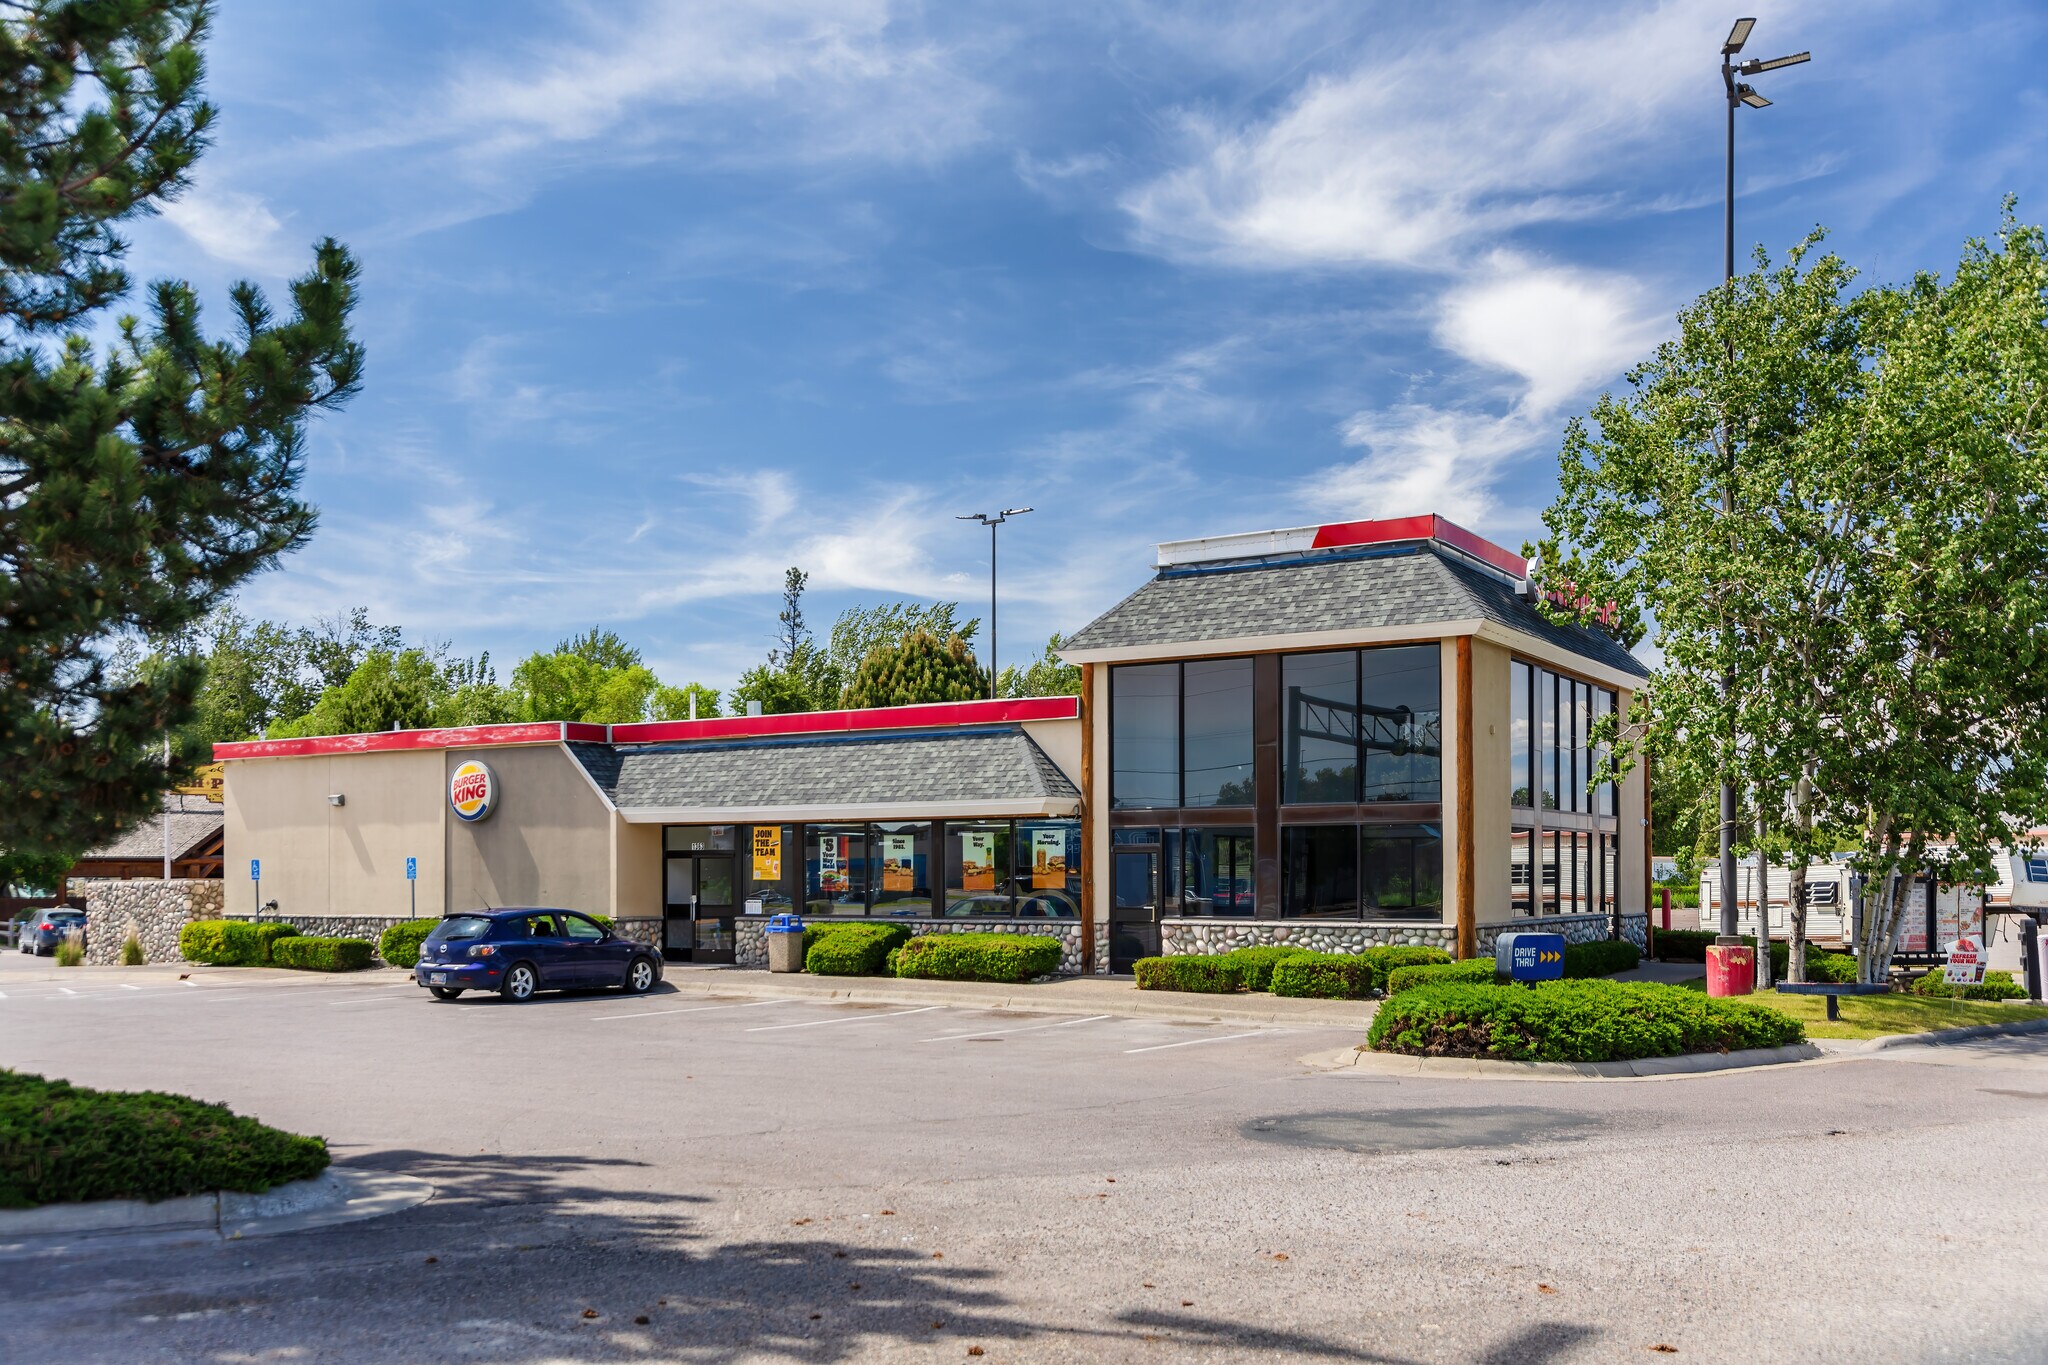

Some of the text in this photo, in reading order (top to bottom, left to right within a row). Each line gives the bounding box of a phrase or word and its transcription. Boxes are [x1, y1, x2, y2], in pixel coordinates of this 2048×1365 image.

[453, 773, 486, 791] BURGER
[453, 784, 487, 806] KING
[755, 829, 773, 839] JOIN
[755, 838, 770, 847] THE
[755, 847, 776, 857] TEAM
[822, 857, 834, 865] Way
[1514, 947, 1537, 957] DRIVE
[1515, 957, 1535, 968] THRU
